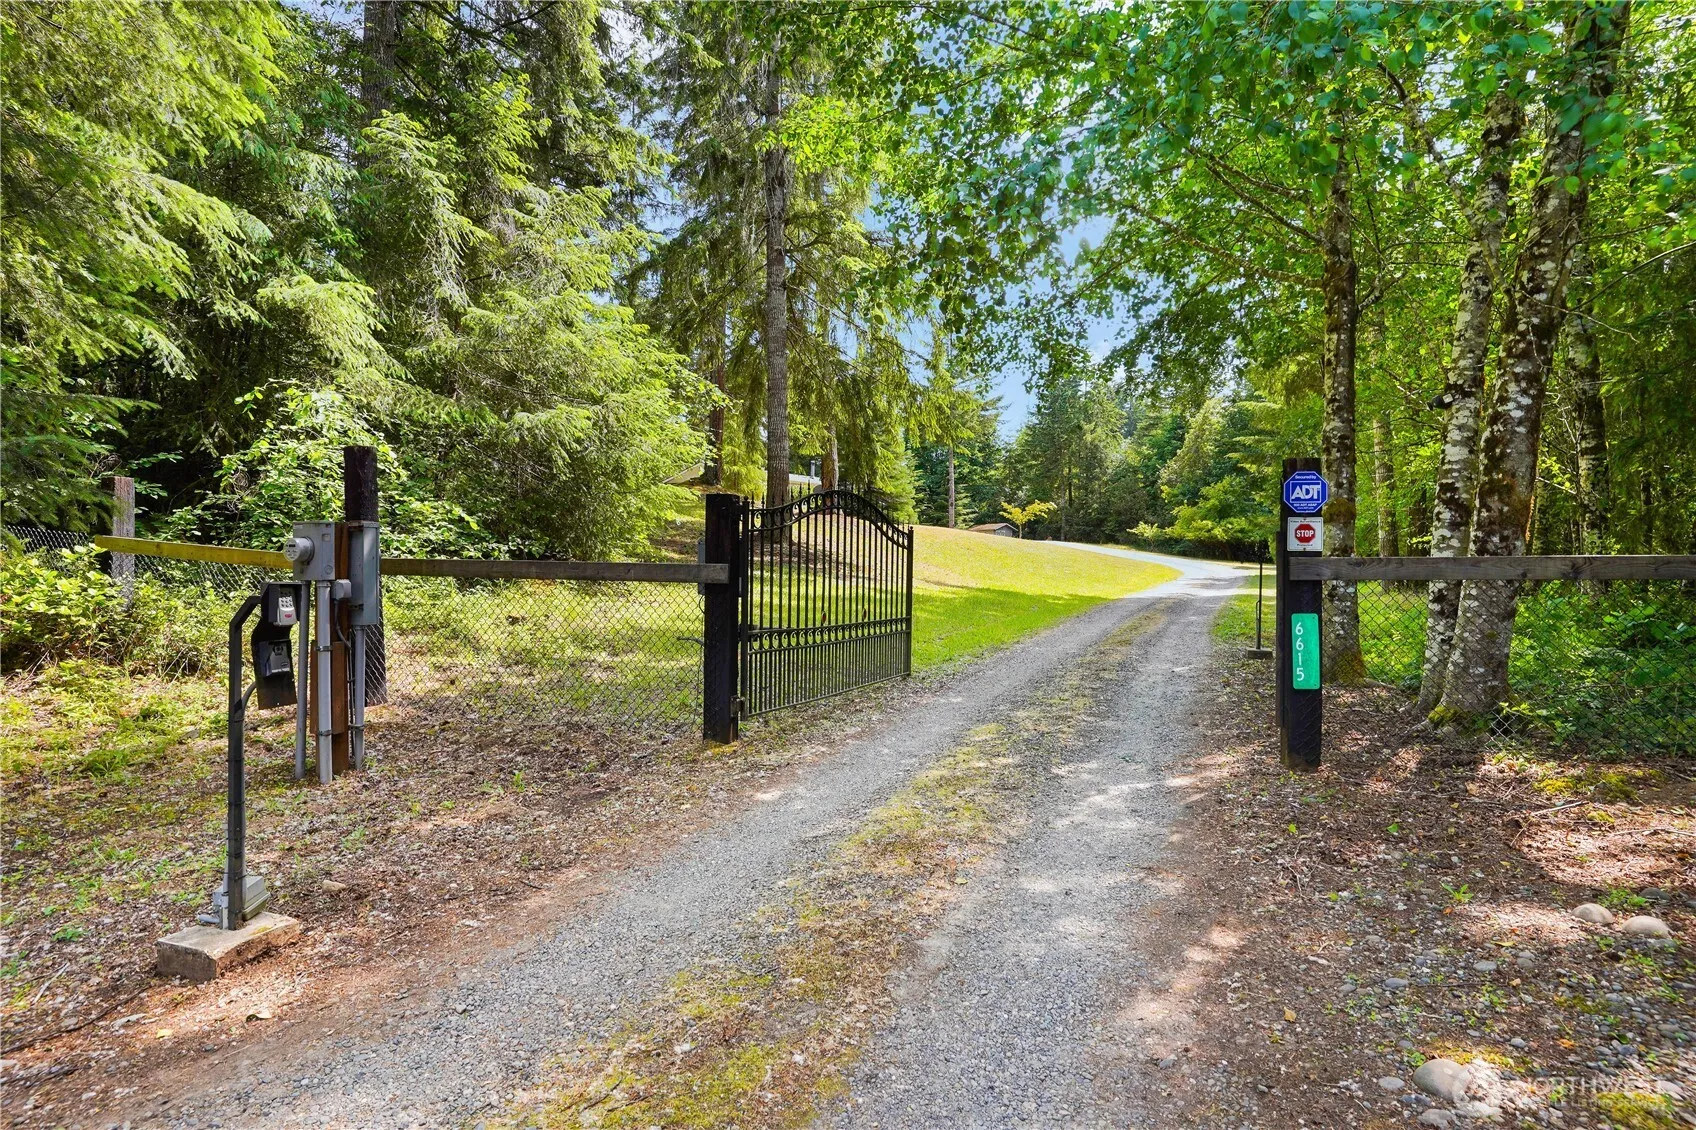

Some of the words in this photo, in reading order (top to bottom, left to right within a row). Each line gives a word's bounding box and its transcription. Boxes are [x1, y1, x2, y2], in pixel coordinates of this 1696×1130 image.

[1291, 485, 1320, 499] ADT
[1296, 529, 1314, 538] STOP
[1295, 622, 1305, 681] 6615
